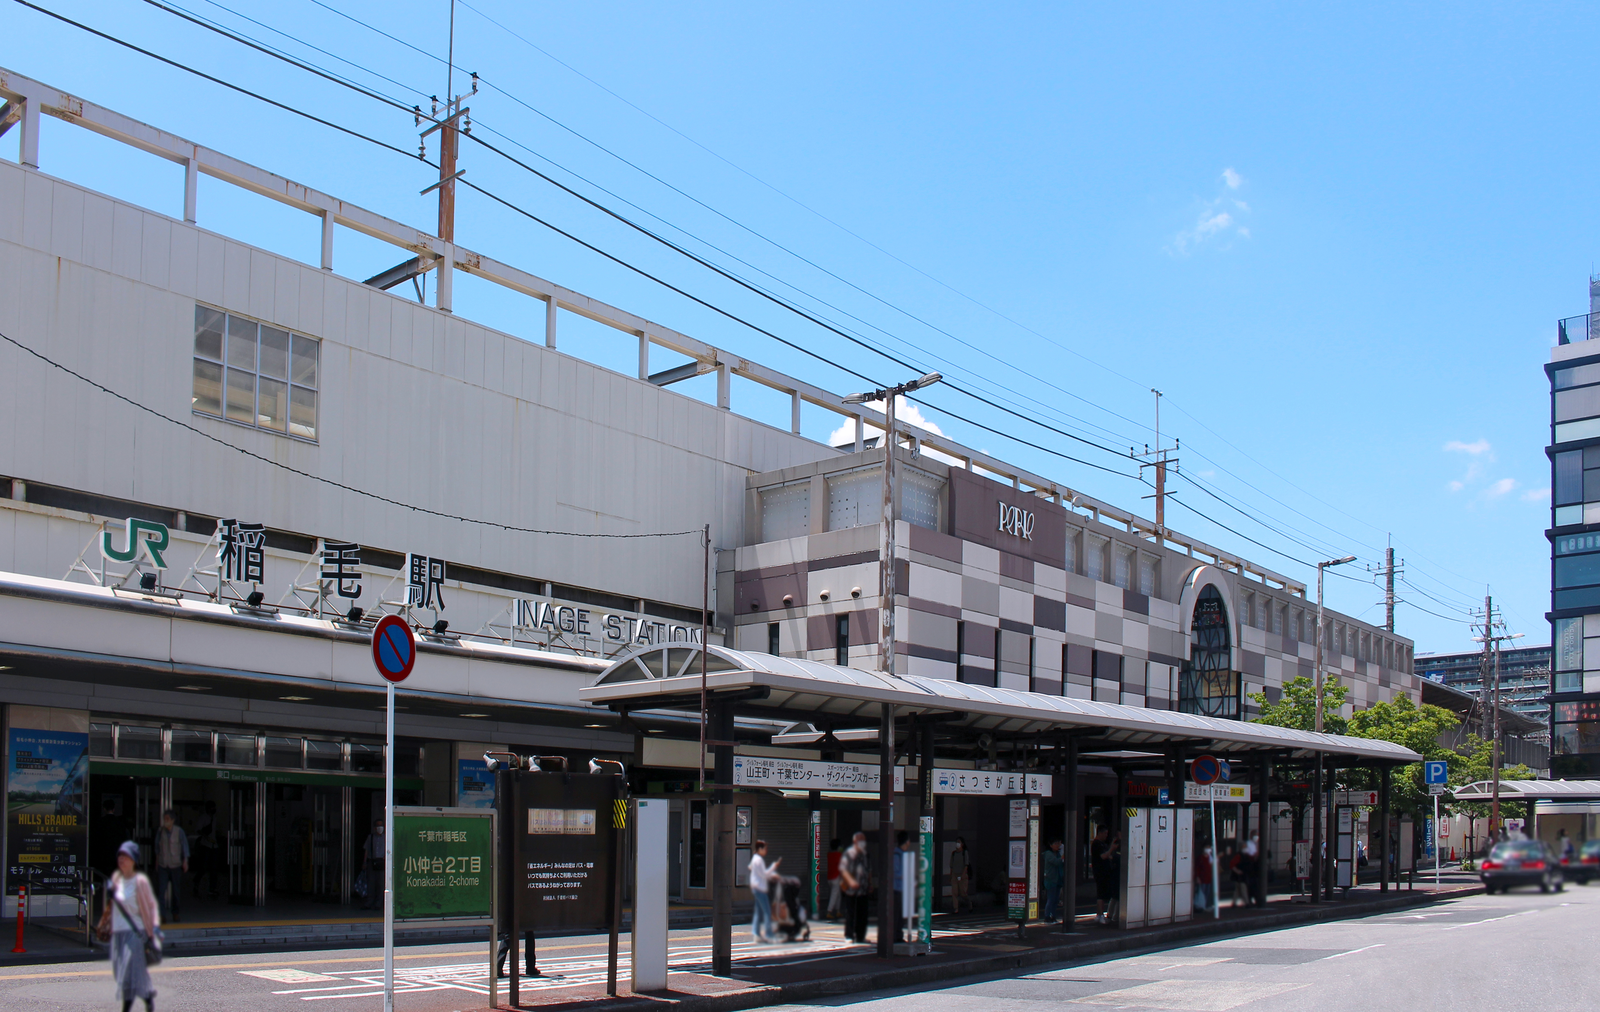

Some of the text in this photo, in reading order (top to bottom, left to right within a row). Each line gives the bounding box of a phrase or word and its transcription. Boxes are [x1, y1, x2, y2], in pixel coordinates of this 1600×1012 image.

[100, 517, 446, 613] JR 稲毛駅
[512, 598, 704, 646] INAGE STATION
[216, 770, 230, 779] 東口
[1430, 764, 1443, 782] P
[18, 813, 78, 826] HILLS GRANDE
[418, 830, 468, 843] 千葉市稲毛区
[403, 856, 482, 874] 小仲台2丁目
[406, 875, 480, 887] Konakadai 2-chome
